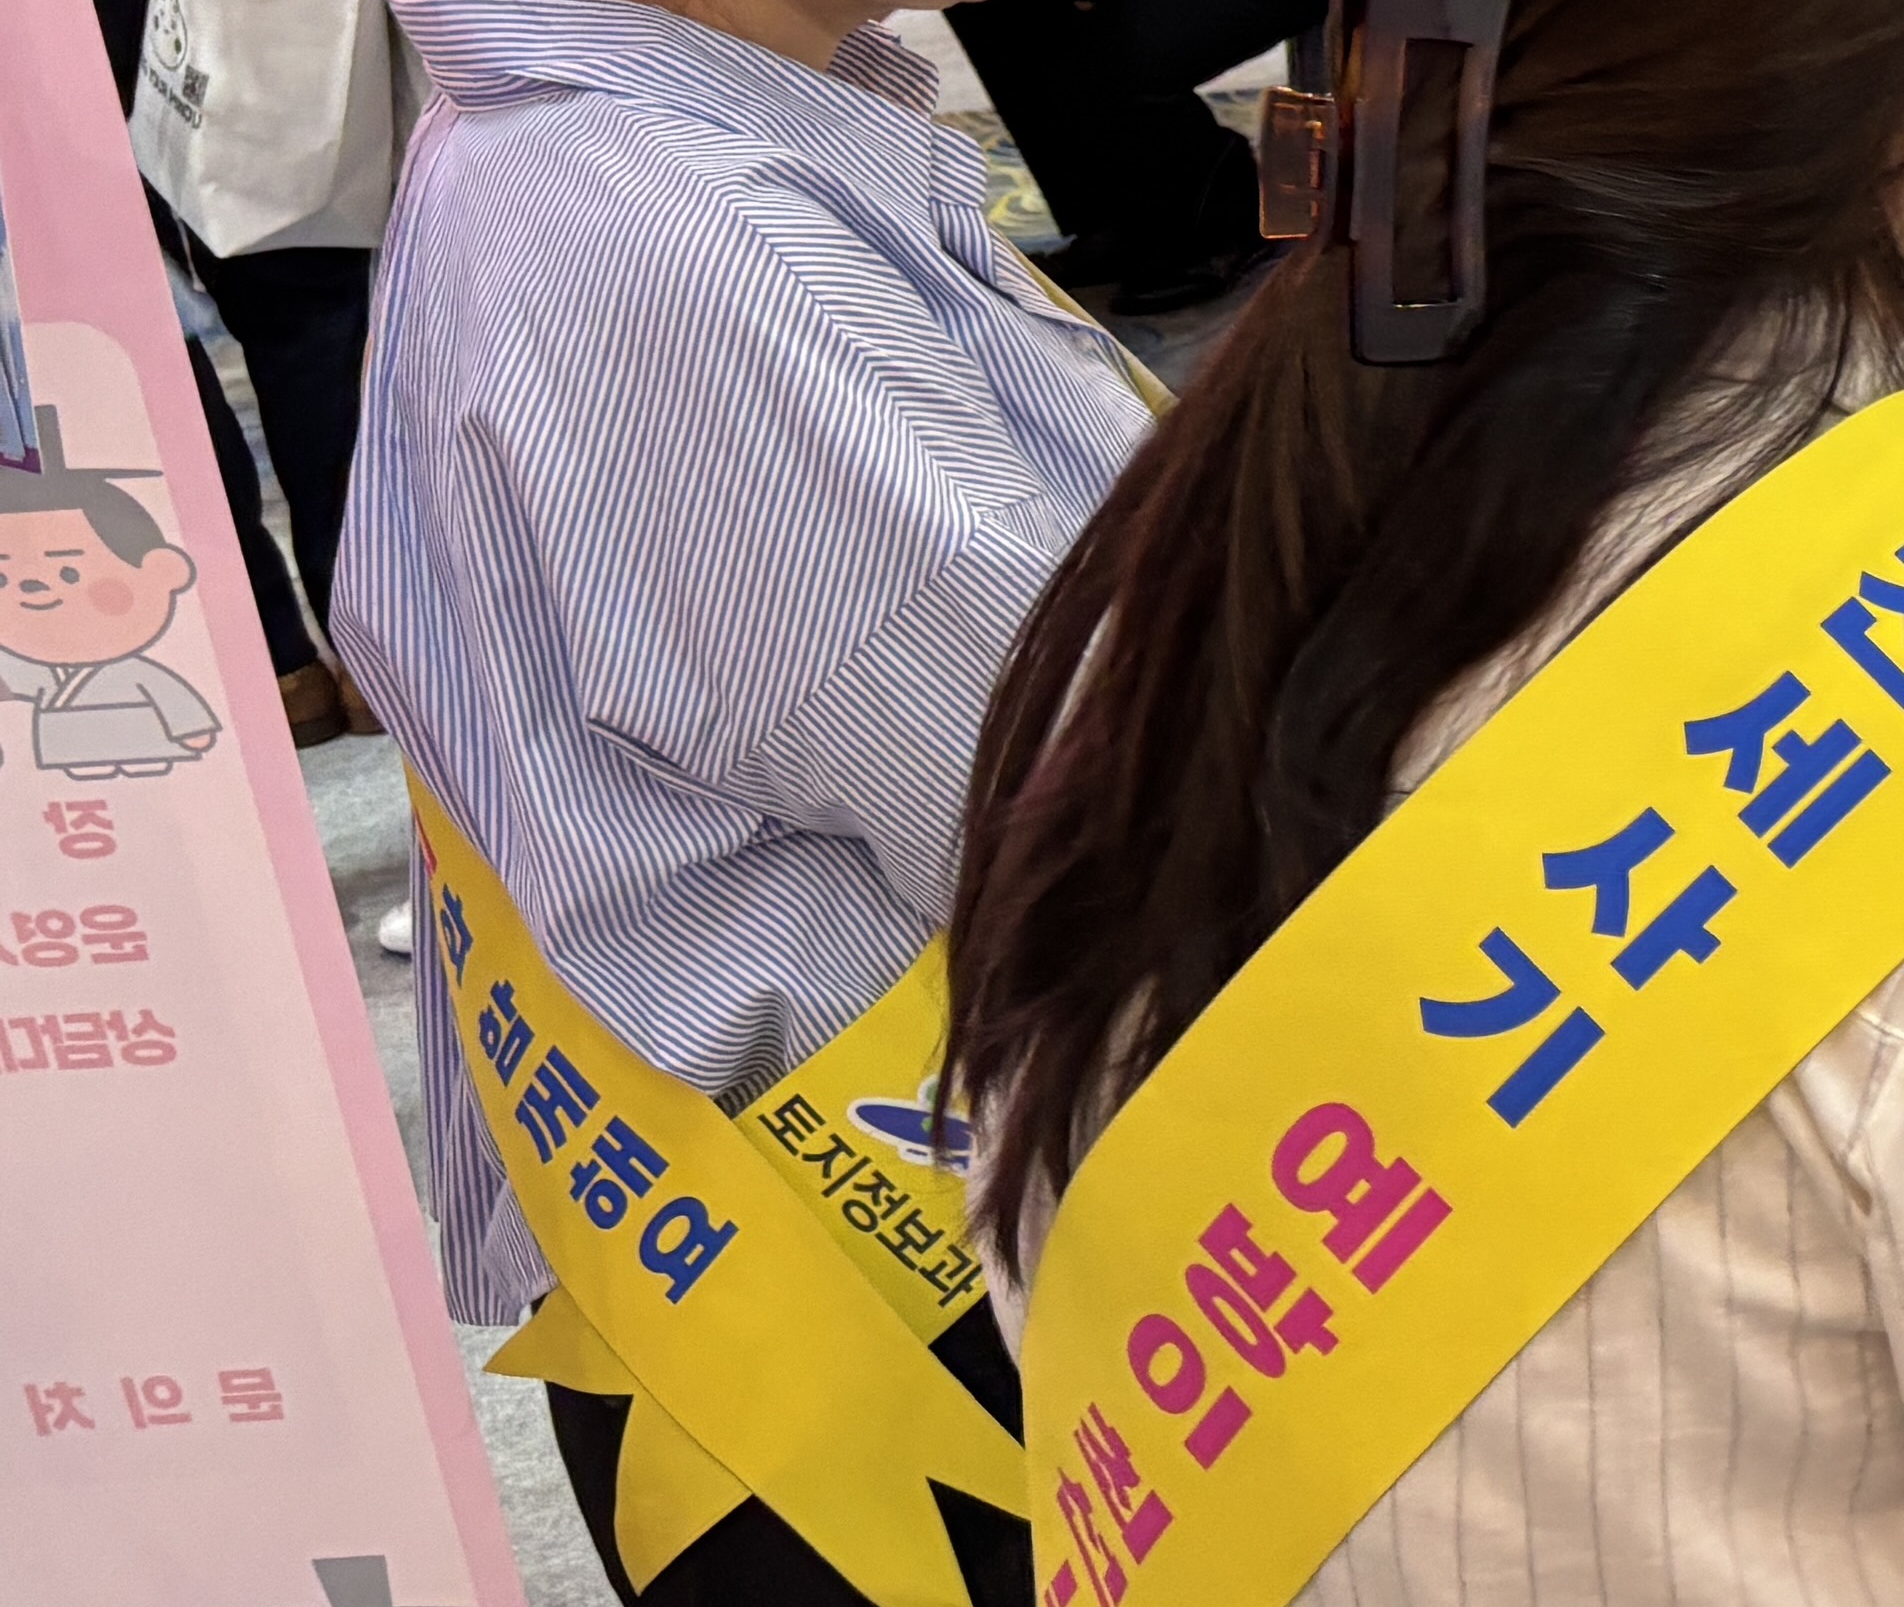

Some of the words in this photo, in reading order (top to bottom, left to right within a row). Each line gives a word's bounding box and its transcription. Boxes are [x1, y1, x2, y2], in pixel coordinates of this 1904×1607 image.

[477, 979, 739, 1305] 함께해요
[757, 1093, 983, 1307] 토지정보과
[1126, 1100, 1453, 1471] 예방이
